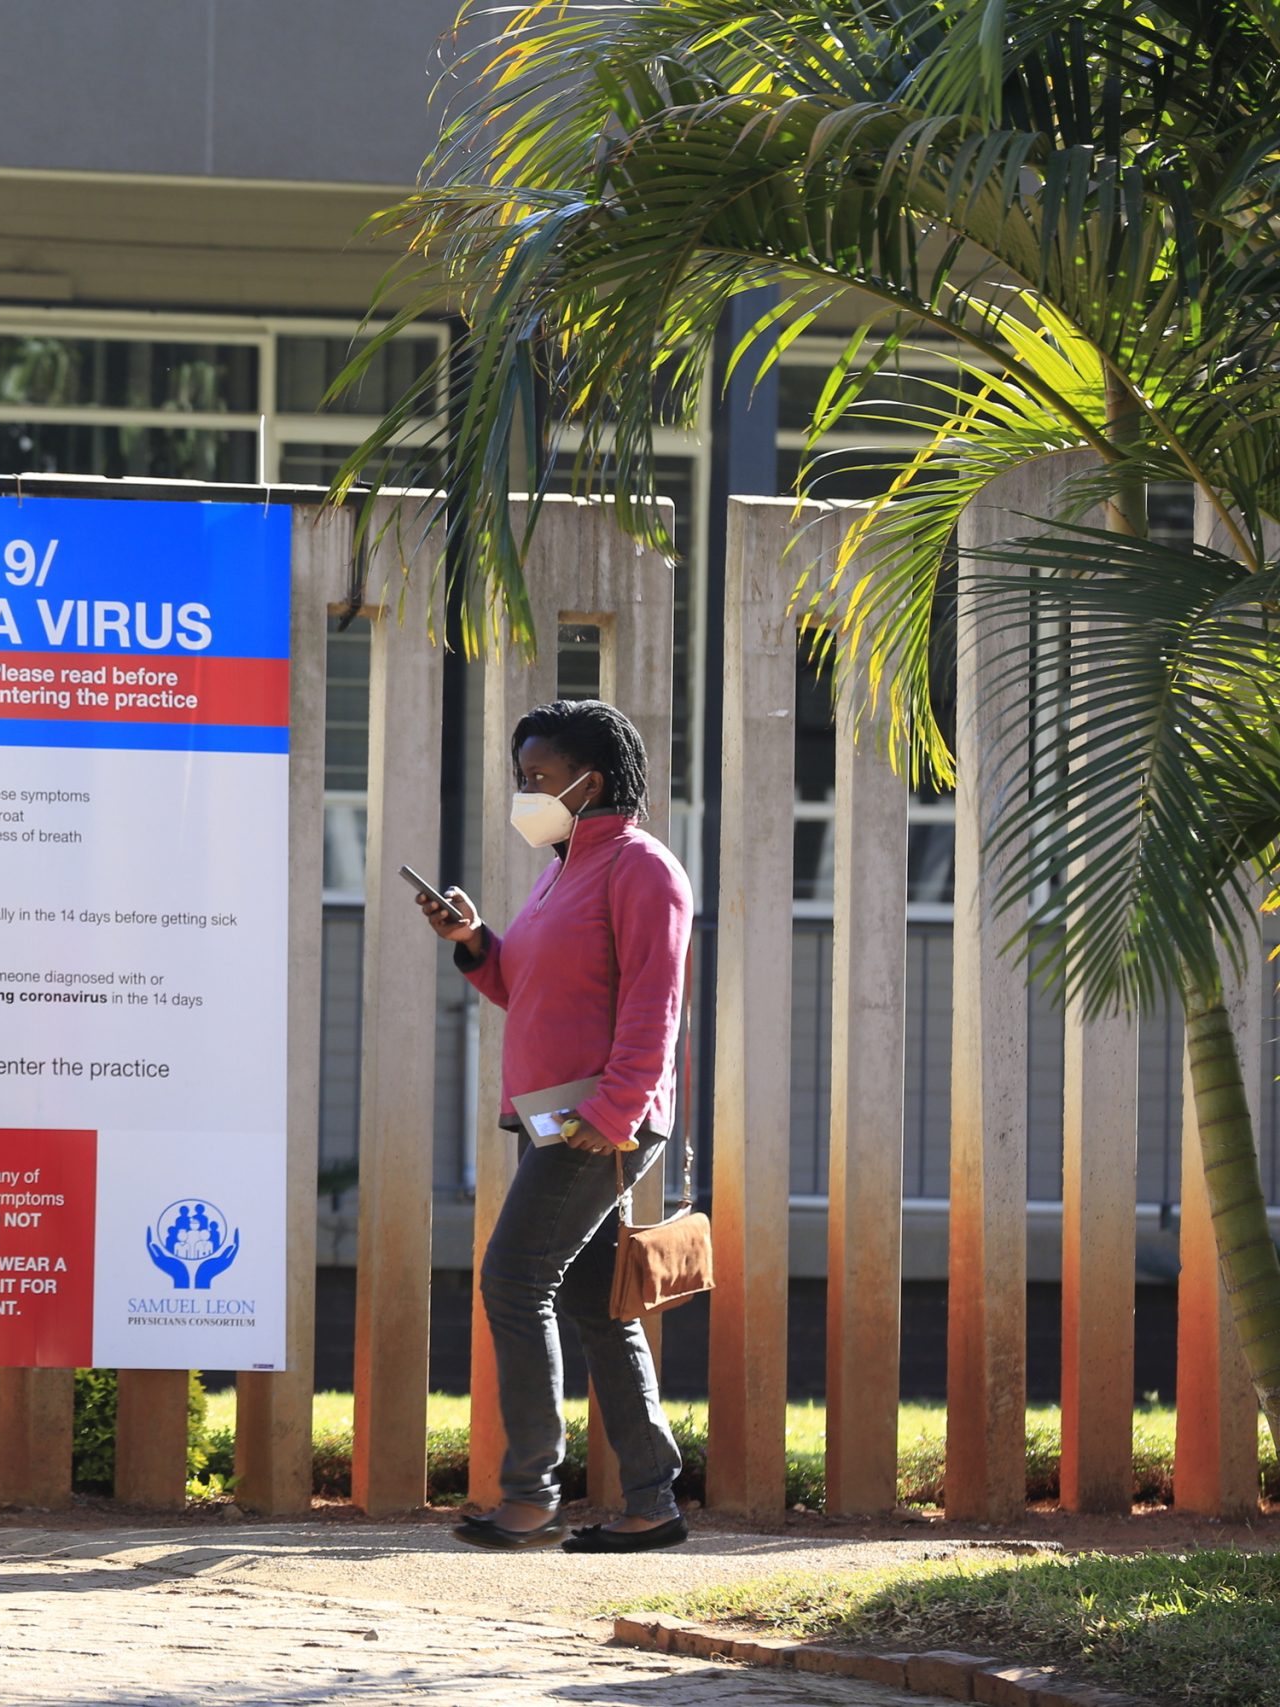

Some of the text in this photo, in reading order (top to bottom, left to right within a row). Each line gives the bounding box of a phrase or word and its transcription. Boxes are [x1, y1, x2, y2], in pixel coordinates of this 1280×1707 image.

[36, 599, 212, 650] VIRUS
[61, 666, 106, 684] read
[113, 667, 178, 686] before
[76, 688, 109, 706] the
[115, 690, 197, 710] practice
[21, 790, 90, 804] symptoms
[22, 829, 34, 842] of
[39, 830, 81, 843] breath
[19, 908, 30, 920] in
[35, 909, 56, 921] the
[61, 910, 74, 921] 14
[79, 910, 110, 925] days
[115, 911, 157, 924] before
[161, 913, 206, 928] getting
[211, 913, 237, 926] sick
[45, 970, 114, 986] diagnosed
[119, 972, 146, 984] with
[151, 976, 164, 985] or
[20, 991, 107, 1003] coronavirus
[112, 992, 123, 1004] in
[128, 992, 148, 1004] the
[154, 993, 167, 1005] 14
[172, 993, 203, 1009] days
[52, 1057, 83, 1076] the
[91, 1059, 169, 1080] practice
[24, 1169, 40, 1183] of
[5, 1212, 41, 1227] NOT
[54, 1257, 67, 1272] A
[21, 1279, 56, 1293] FOR
[128, 1299, 255, 1314] SAMUEL LEON
[128, 1317, 255, 1327] PHYSICIANS CONSORTIUM
